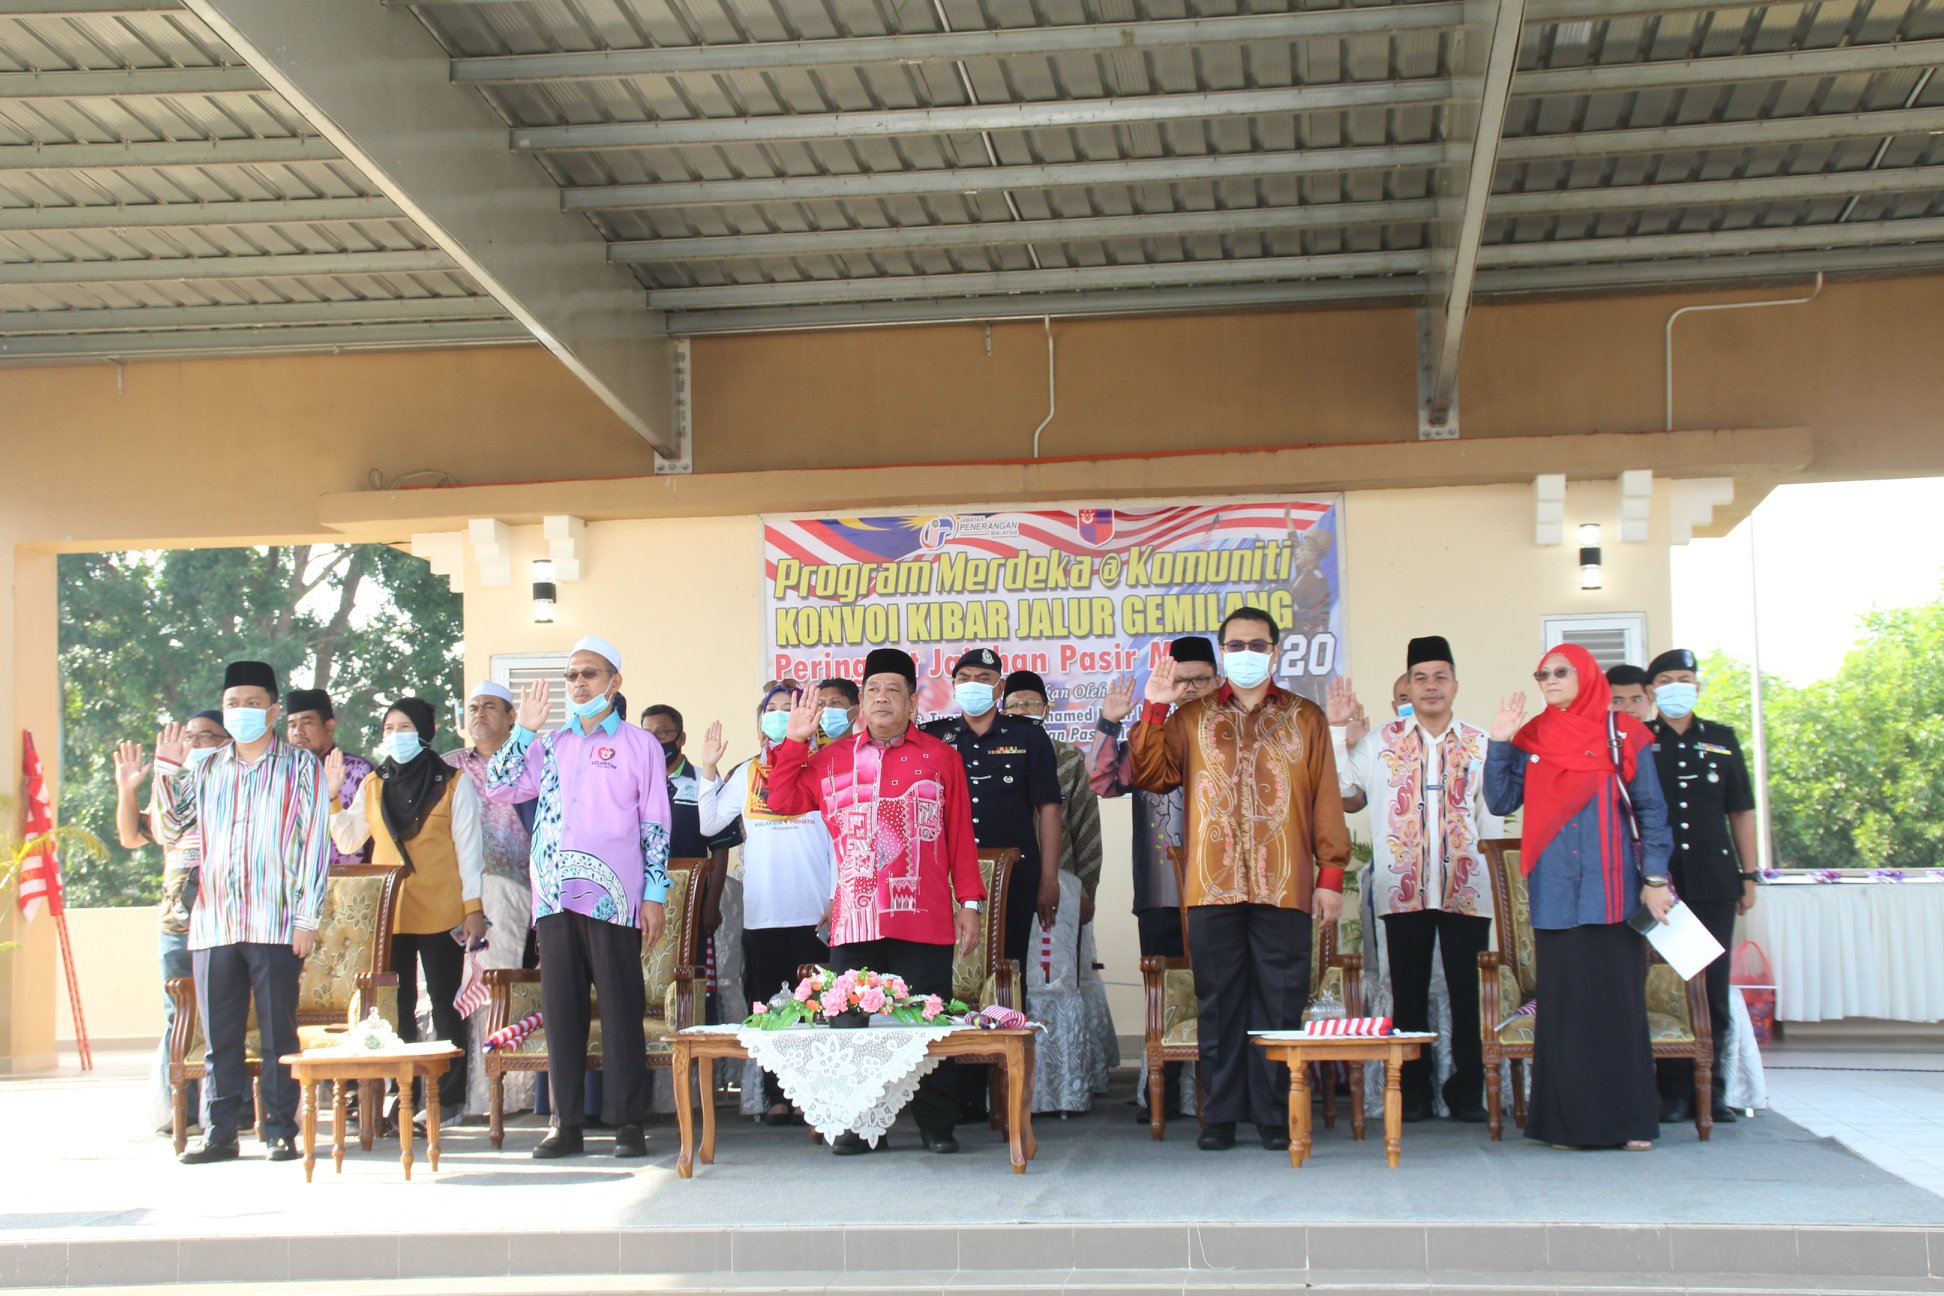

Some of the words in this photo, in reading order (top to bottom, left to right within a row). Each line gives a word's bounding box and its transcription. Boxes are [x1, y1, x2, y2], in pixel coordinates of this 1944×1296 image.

[960, 522, 1017, 530] PENERANGAN
[774, 558, 932, 602] Program
[937, 548, 1092, 593] Merdeka
[1126, 539, 1294, 586] Komuniti
[775, 603, 899, 646] KONVOI
[906, 600, 1010, 641] KIBAR
[1016, 596, 1115, 638] JALUR
[775, 652, 919, 684] Pering
[929, 645, 1048, 676] Jahan
[1060, 642, 1137, 672] Pasir
[1073, 682, 1107, 700] Oleh
